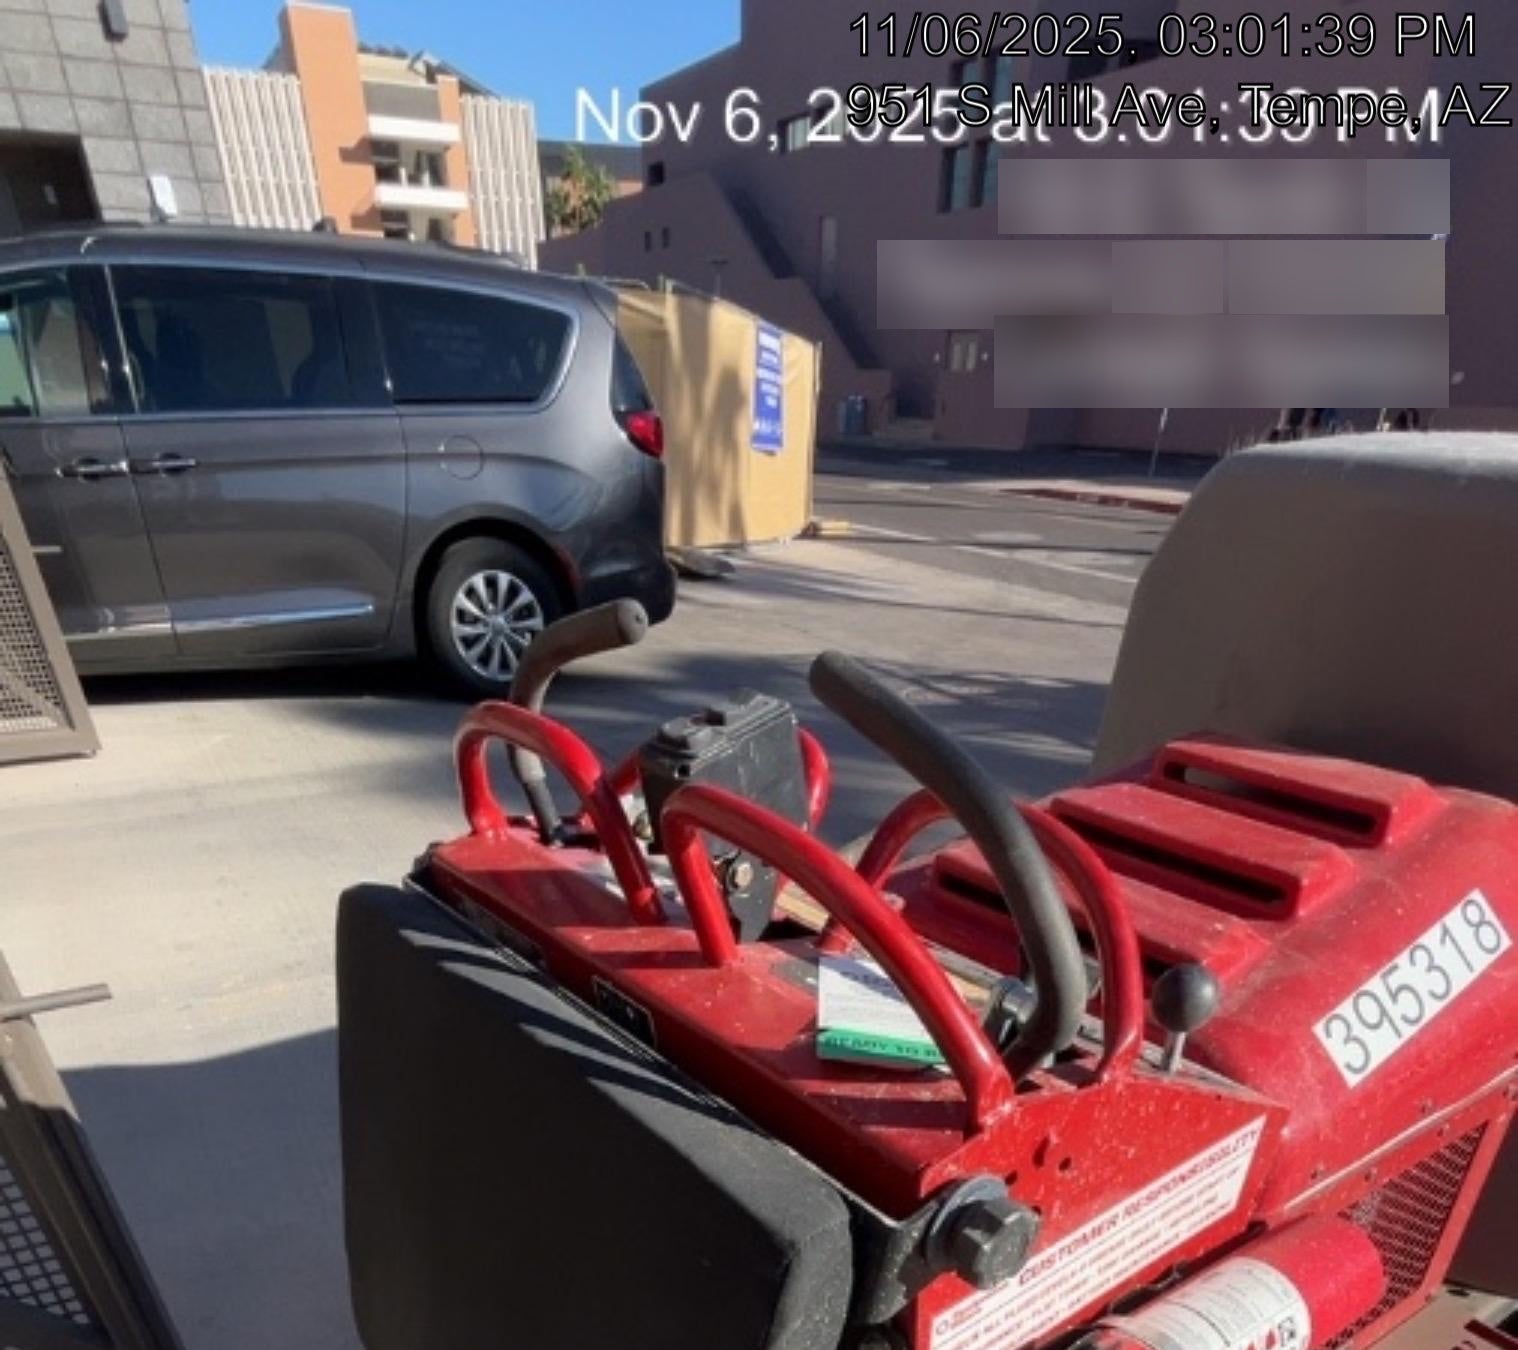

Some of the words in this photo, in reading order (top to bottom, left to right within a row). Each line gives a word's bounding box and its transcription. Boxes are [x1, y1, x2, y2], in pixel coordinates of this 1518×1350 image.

[1325, 899, 1500, 1075] 395318
[1019, 1212, 1120, 1286] CUSTOMER
[1121, 1130, 1257, 1221] RESPONSIBILITY
